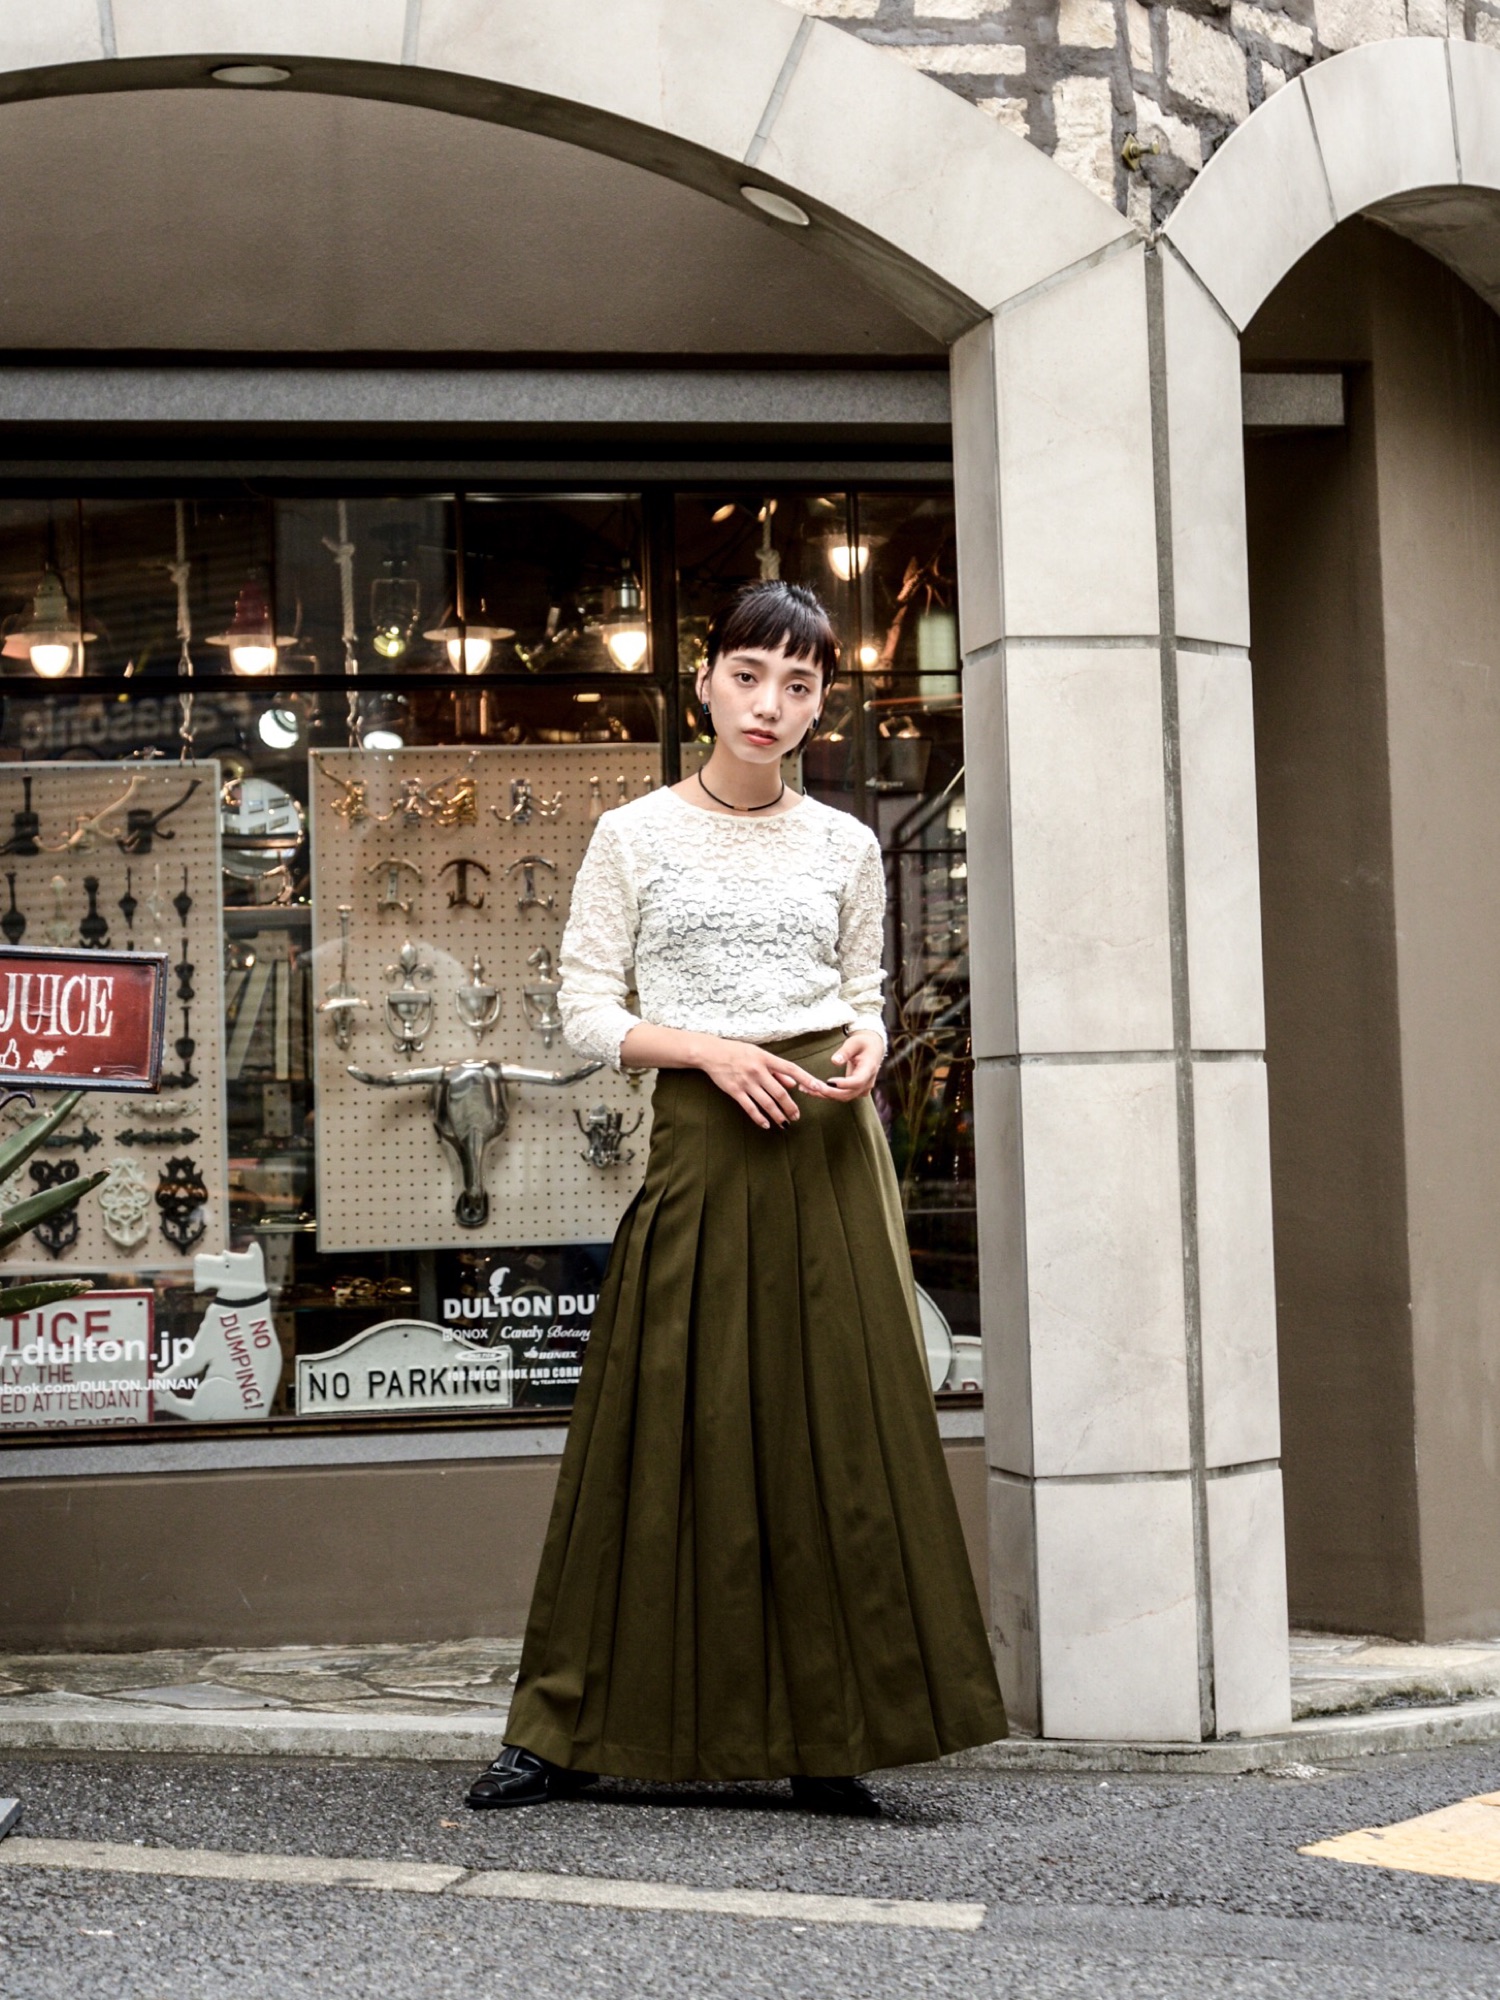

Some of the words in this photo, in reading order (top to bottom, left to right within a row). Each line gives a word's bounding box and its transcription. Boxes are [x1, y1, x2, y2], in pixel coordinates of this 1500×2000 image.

[0, 973, 114, 1037] JUICE
[444, 1296, 552, 1319] DULTON
[558, 1294, 600, 1315] DU
[249, 1320, 271, 1349] NO
[36, 1363, 73, 1384] THE
[219, 1313, 265, 1410] DUMPING!
[530, 1367, 550, 1379] AND
[309, 1371, 350, 1402] NO
[368, 1365, 500, 1399] PARKING
[33, 1388, 141, 1412] ATTENDANT
